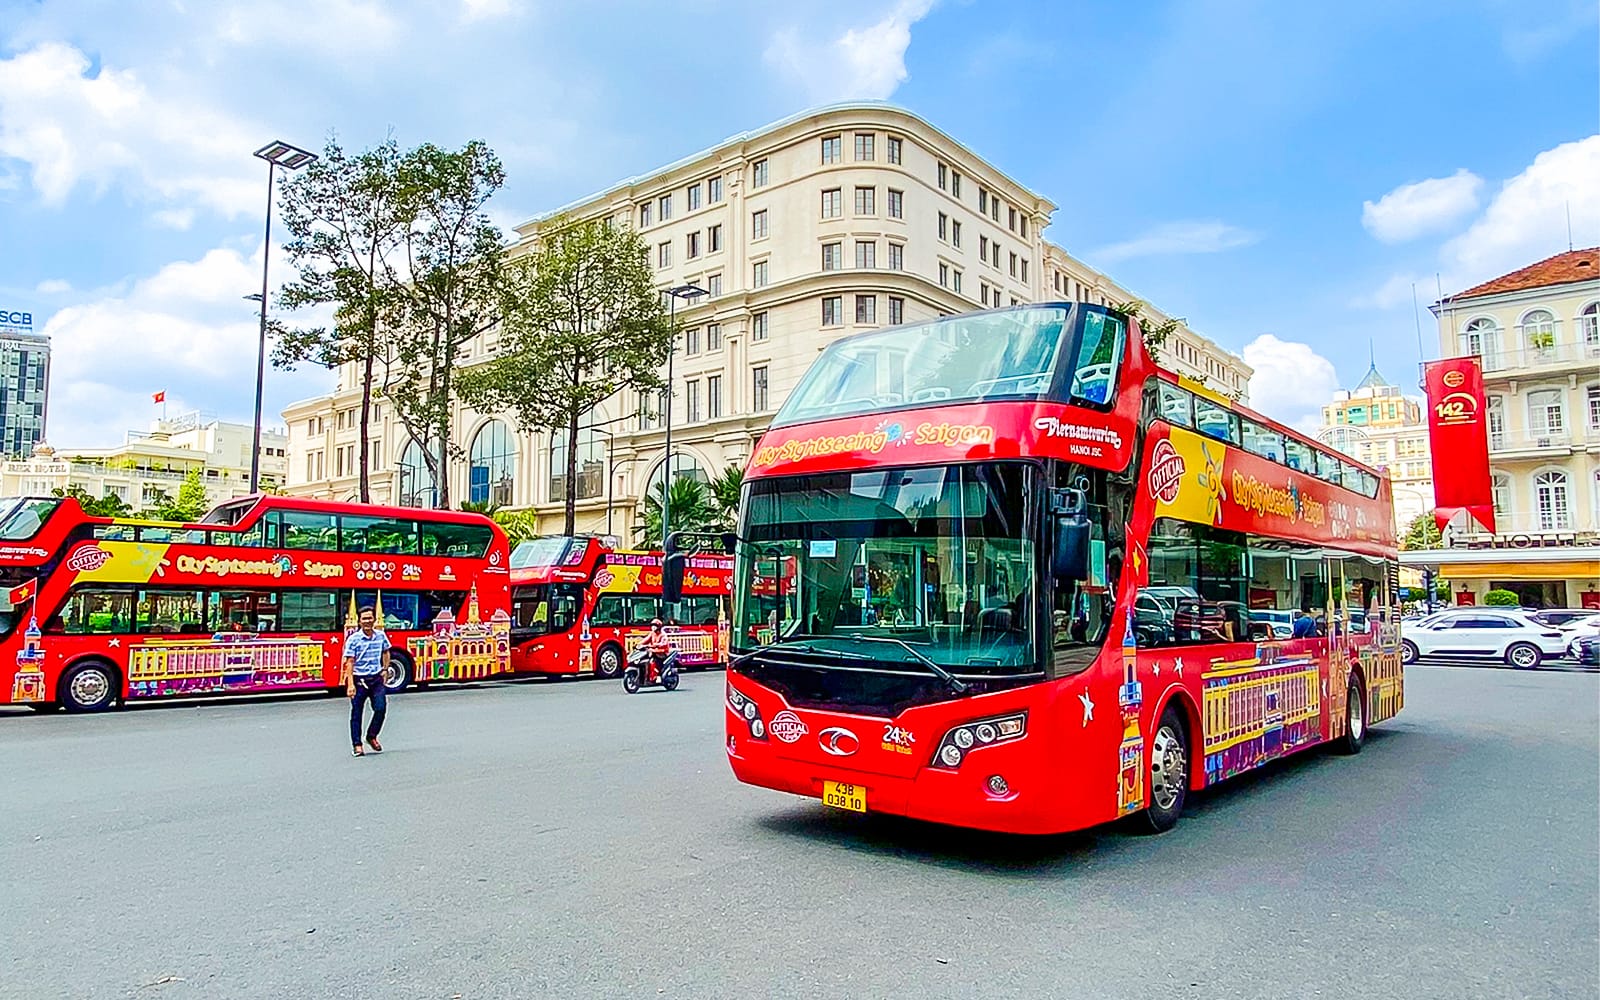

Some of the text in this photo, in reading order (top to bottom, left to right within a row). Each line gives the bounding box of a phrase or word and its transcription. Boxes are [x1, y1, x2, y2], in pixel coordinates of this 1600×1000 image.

[0, 310, 32, 325] SCB
[1435, 402, 1464, 417] 142
[914, 422, 994, 447] Saigon
[1069, 444, 1091, 456] HANOI
[35, 464, 67, 473] HOTEL
[1152, 457, 1185, 492] OFFICIAL
[72, 552, 112, 568] OFFICIAL
[303, 559, 344, 578] Saigon
[772, 722, 805, 732] OFFICIAL
[827, 793, 862, 810] 038.10
